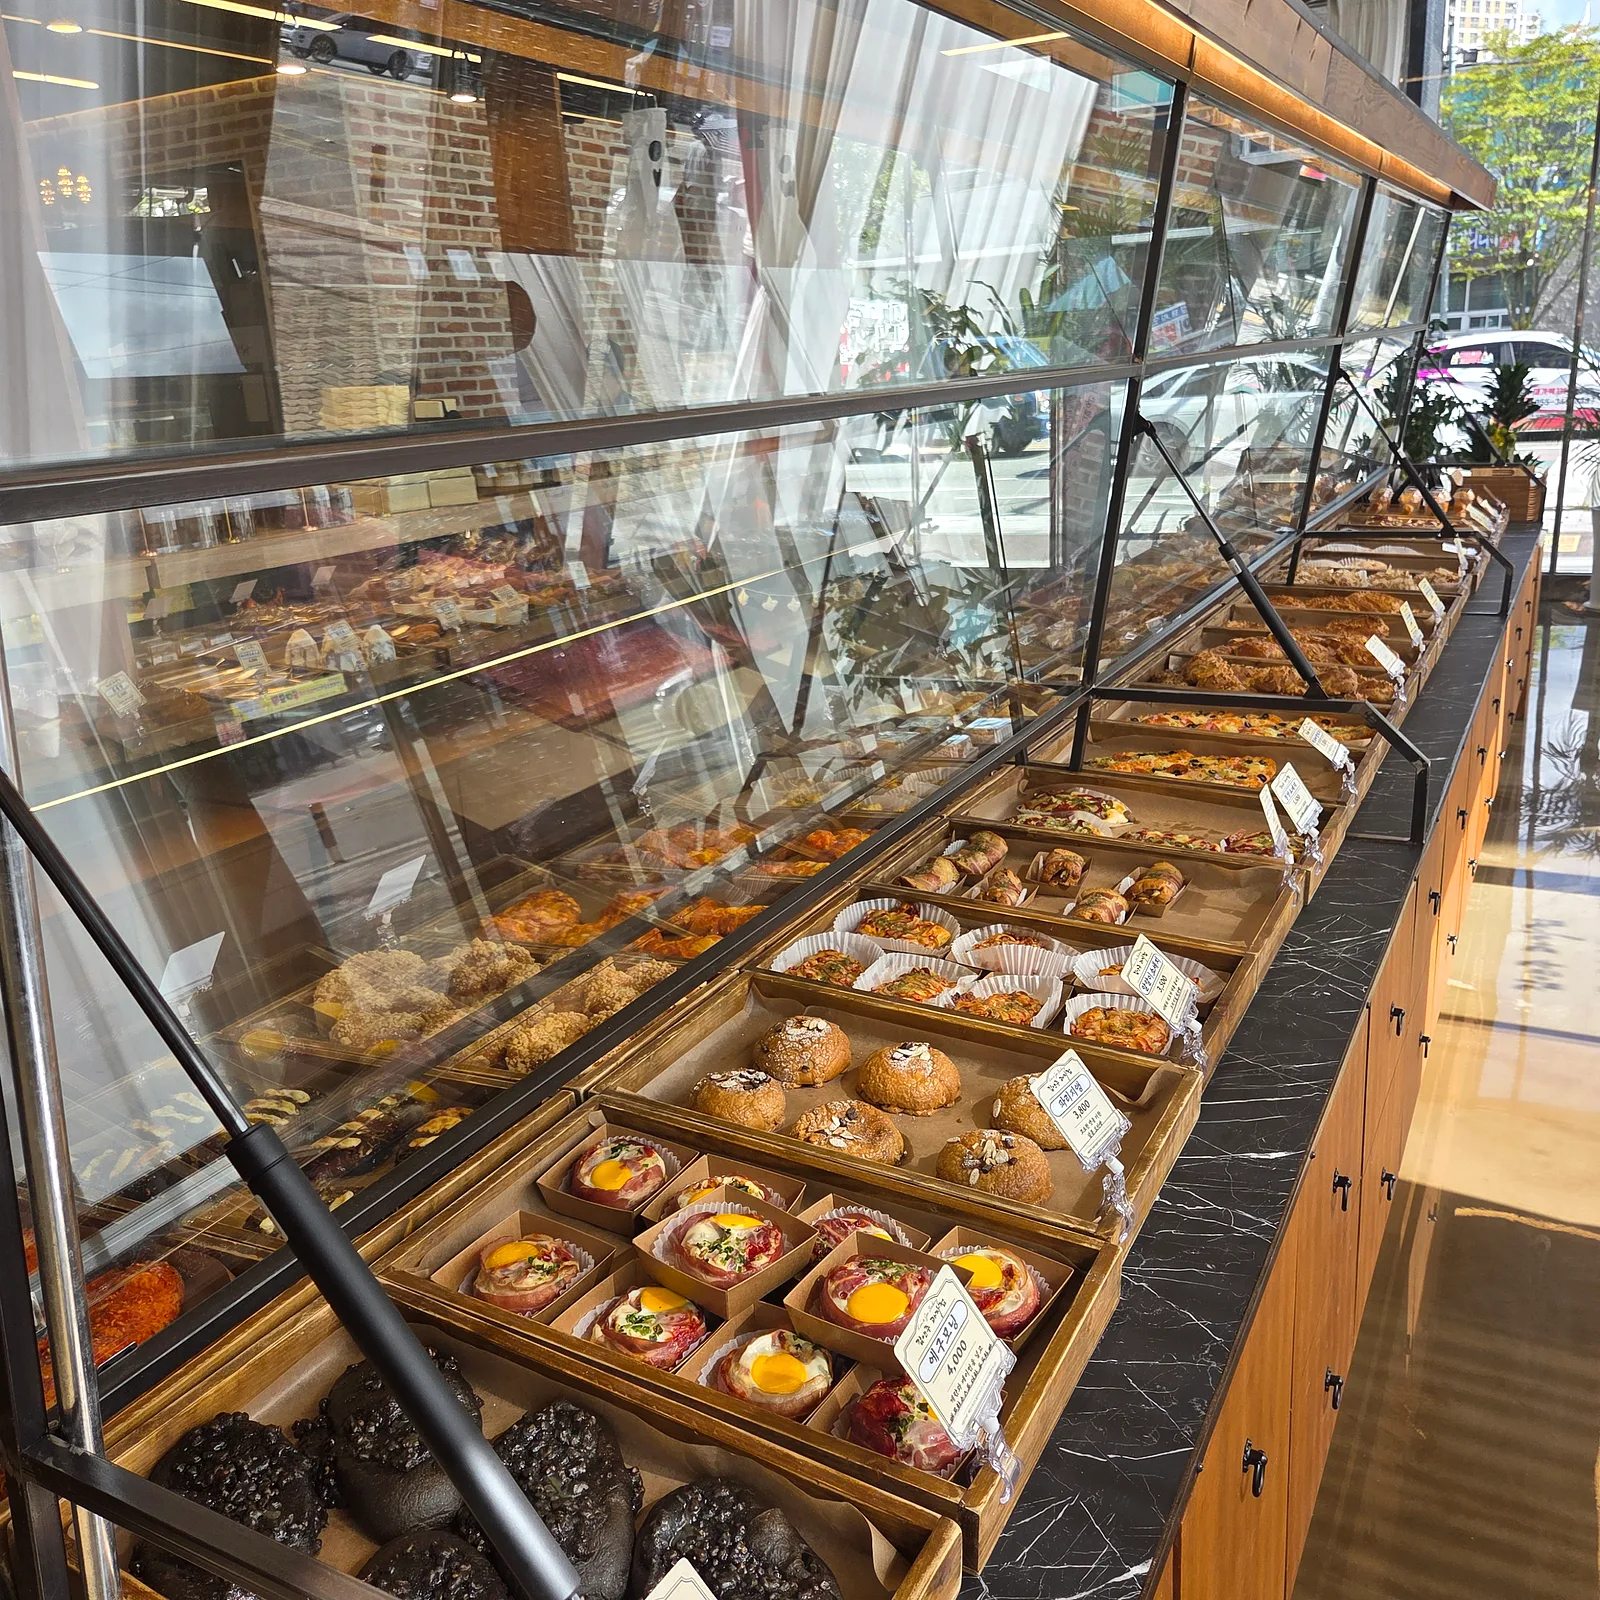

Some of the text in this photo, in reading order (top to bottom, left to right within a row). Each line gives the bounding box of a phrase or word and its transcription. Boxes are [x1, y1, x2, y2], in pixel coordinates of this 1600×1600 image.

[1072, 1099, 1090, 1119] 3,800
[928, 1314, 958, 1364] 에구모닝
[947, 1339, 967, 1375] 4,000
